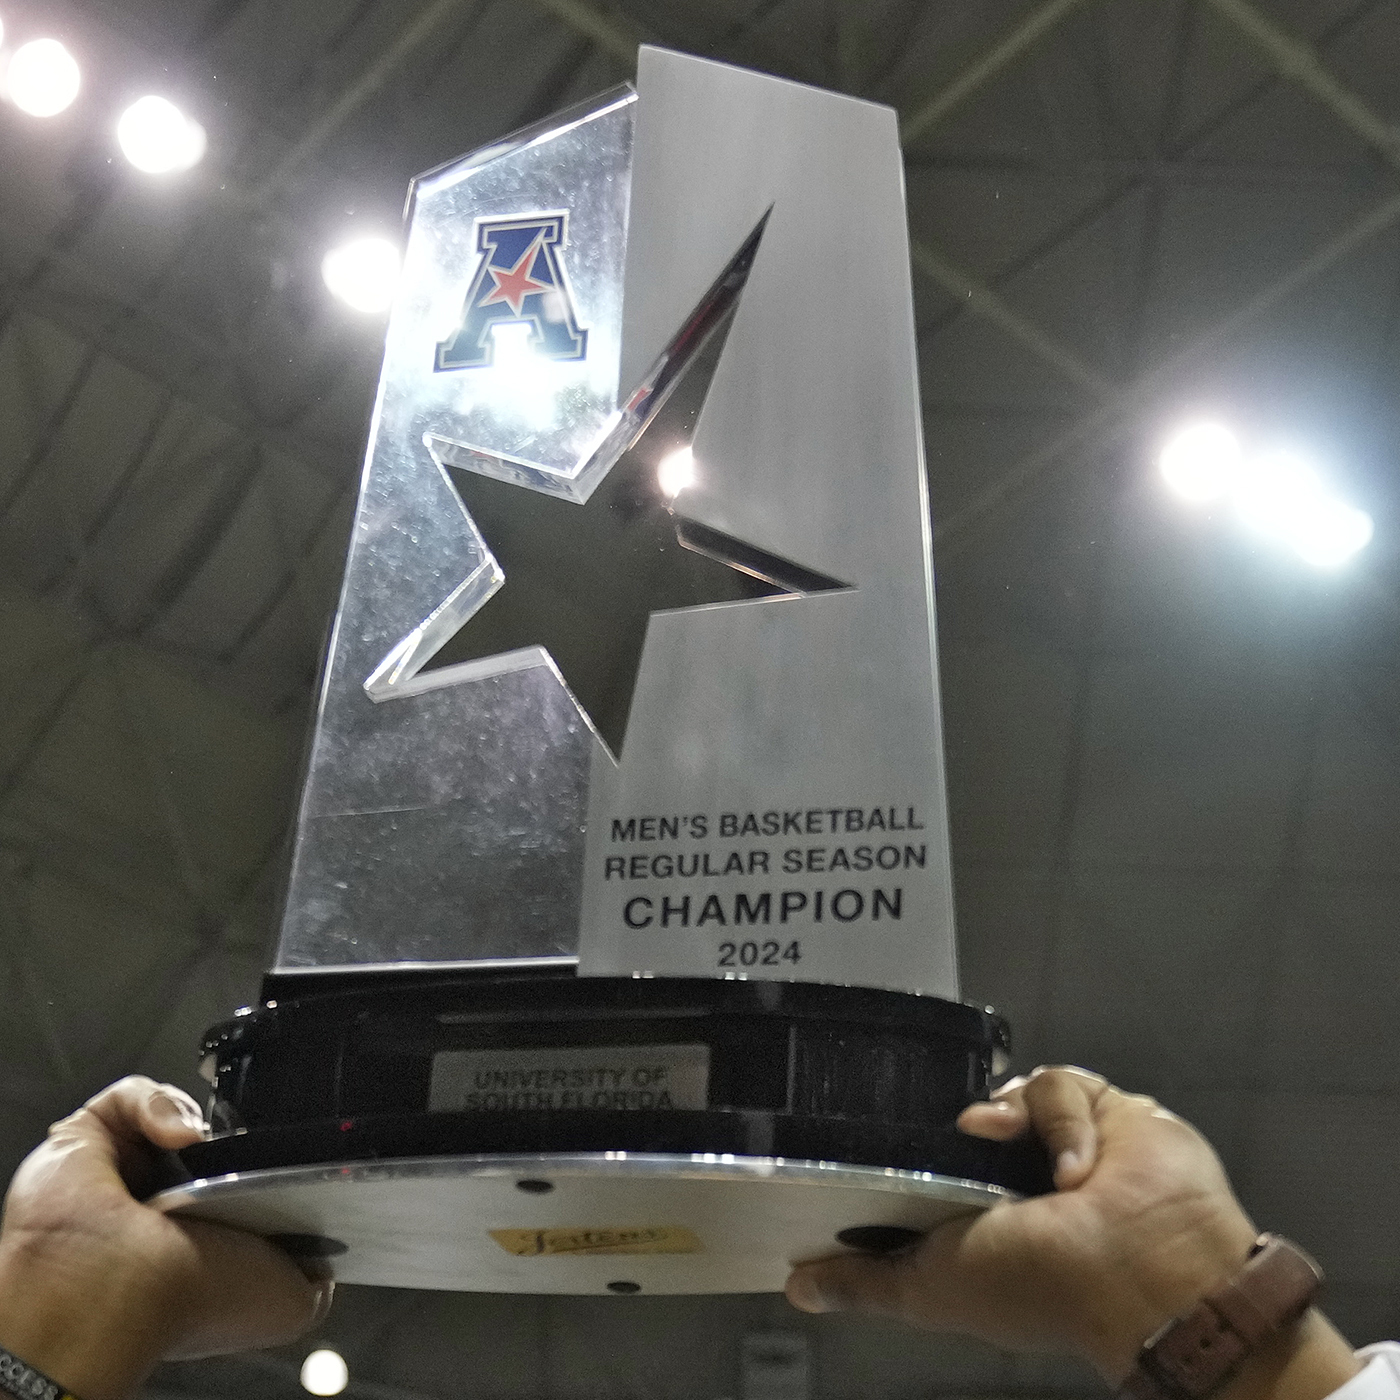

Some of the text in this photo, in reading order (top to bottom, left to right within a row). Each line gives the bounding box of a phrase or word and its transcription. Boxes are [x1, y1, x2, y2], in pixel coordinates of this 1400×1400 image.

[432, 208, 589, 373] A
[611, 807, 926, 842] MEN'S BASKETBALL
[605, 844, 927, 881] REGULAR SEASON
[623, 888, 903, 930] CHAMPION
[718, 941, 802, 967] 2024
[474, 1066, 667, 1090] UNIVERSITY OF
[465, 1090, 674, 1110] SOUTH FLORIDA
